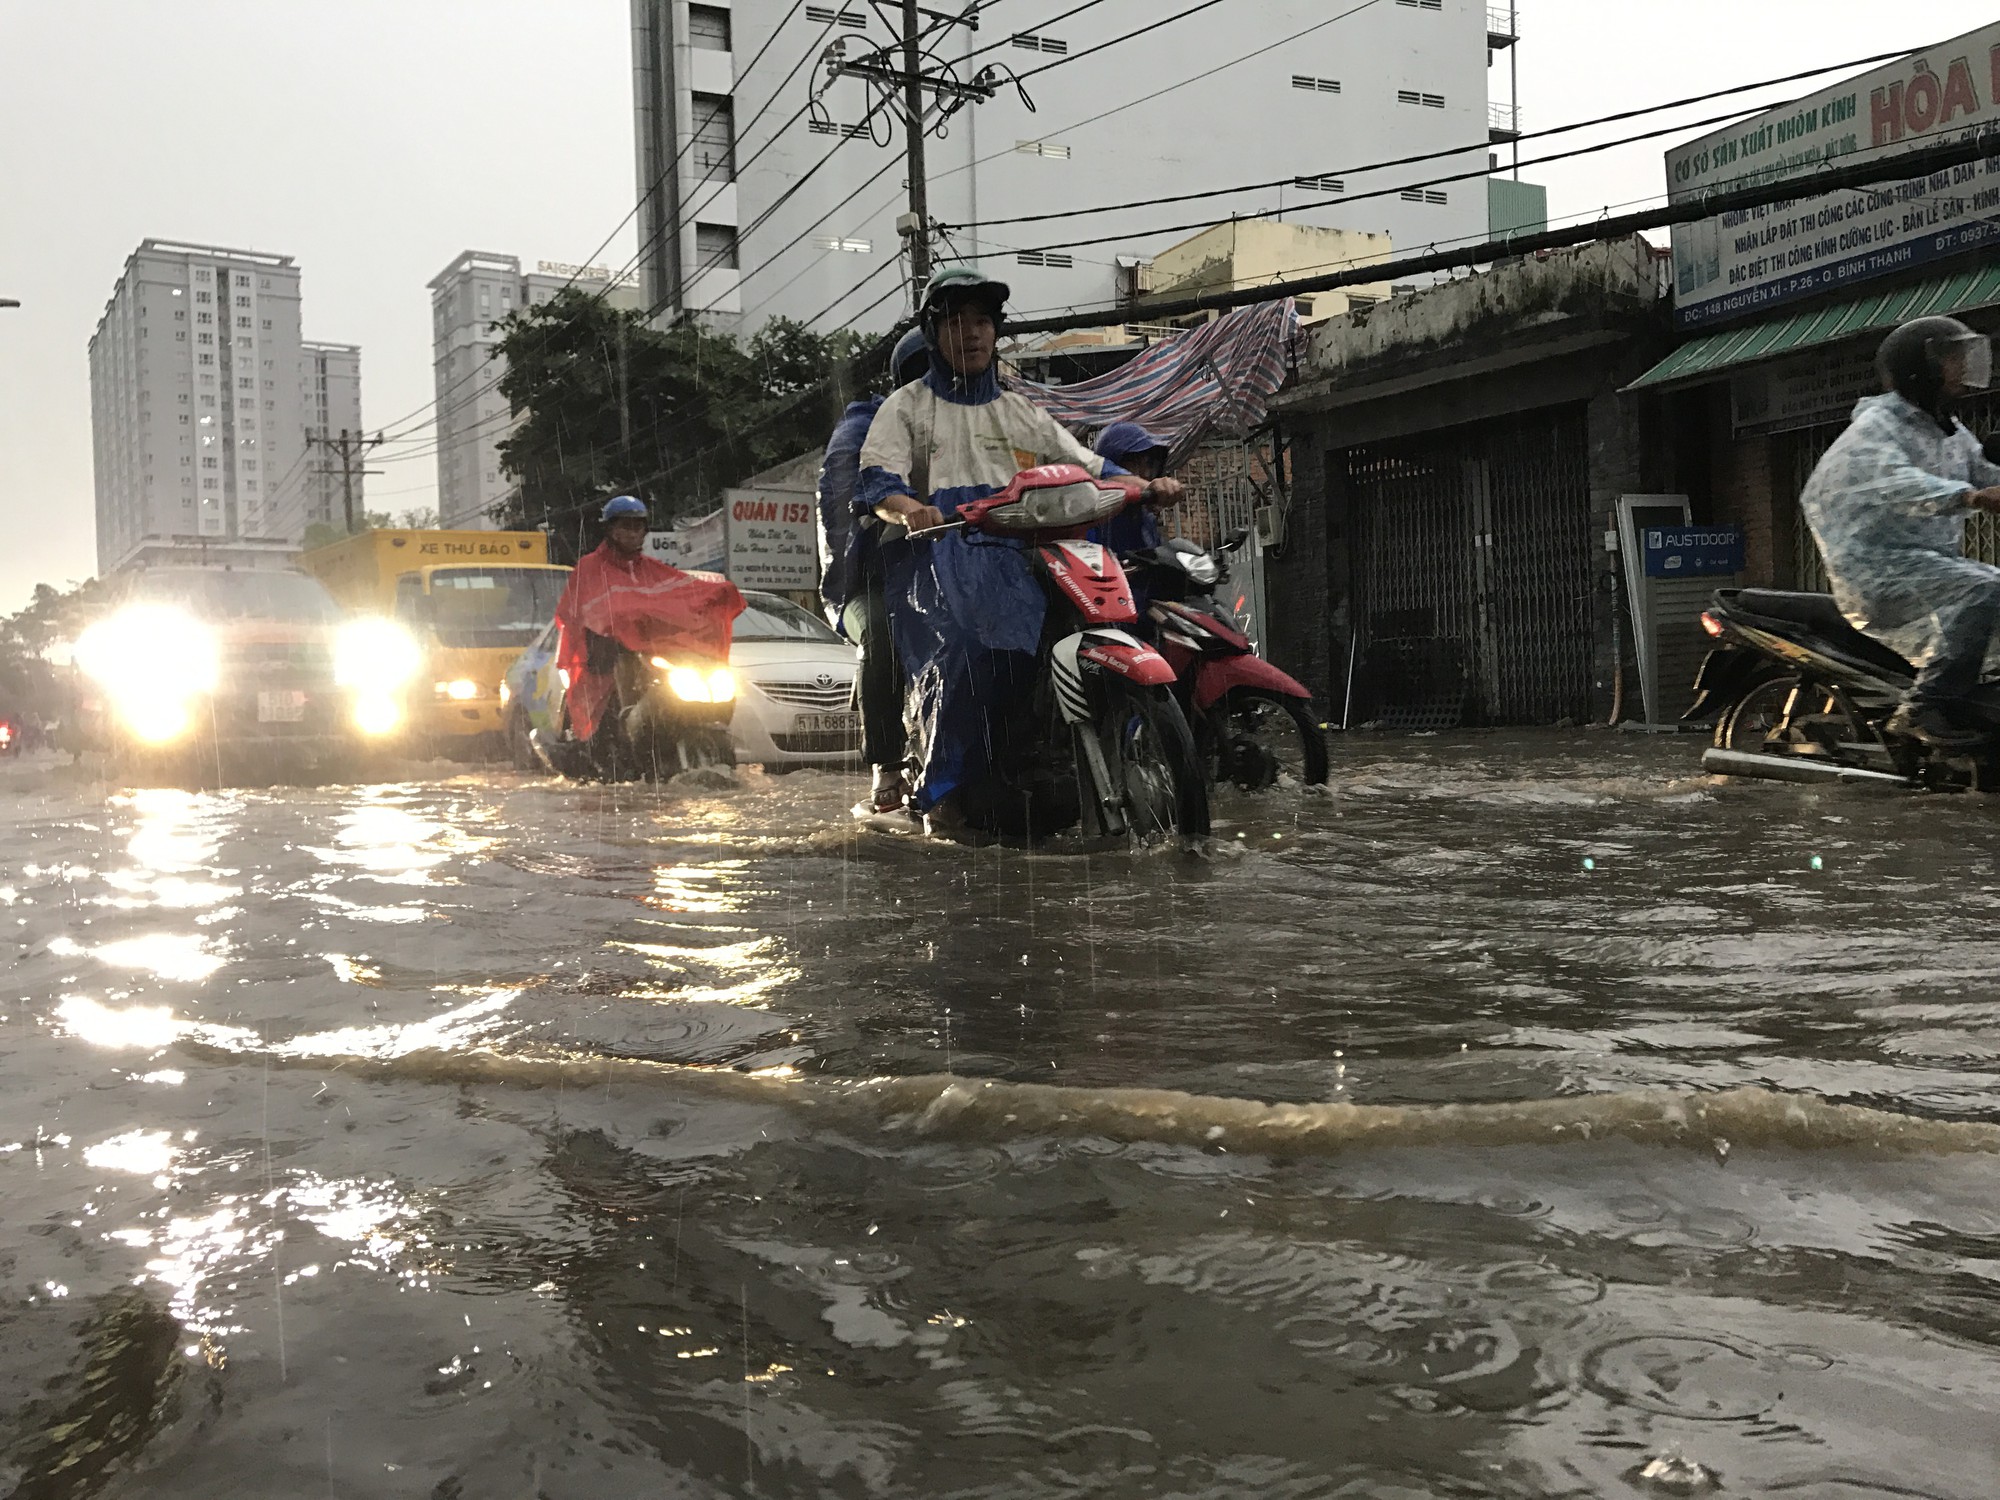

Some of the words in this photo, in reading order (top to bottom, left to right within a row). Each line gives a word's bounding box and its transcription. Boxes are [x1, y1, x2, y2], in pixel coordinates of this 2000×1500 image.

[1870, 56, 1981, 147] HÒA
[1674, 155, 1691, 183] CƠ
[1693, 145, 1709, 177] SỞ
[1713, 137, 1738, 169] SẢN
[1741, 120, 1774, 158] XUẤT
[1777, 108, 1818, 145] NHÔM
[1822, 93, 1857, 128] KÍNH
[1729, 265, 1747, 287] ĐẶC
[1749, 255, 1768, 280] BIỆT
[1771, 253, 1786, 272] THI
[1788, 244, 1813, 267] CÔNG
[1815, 236, 1838, 260] KÍNH
[1902, 205, 1924, 233] BẢN
[1973, 186, 1999, 212] KÍNH
[1735, 231, 1759, 254] NHẬN
[1779, 217, 1798, 243] ĐẶT
[1800, 213, 1816, 232] THI
[1818, 204, 1843, 228] CÔNG
[1845, 195, 1865, 220] CÁC
[1867, 189, 1894, 213] CÔNG
[1704, 302, 1721, 316] 148
[1723, 285, 1768, 311] NGUYỄN
[1790, 275, 1813, 292] P.26
[1838, 258, 1867, 279] BÌNH
[1869, 247, 1912, 269] THẠNH
[733, 497, 778, 523] QUÁN
[782, 503, 810, 524] 152
[1665, 532, 1735, 547] AUSTDOOR
[419, 543, 439, 555] XE
[444, 542, 476, 555] THƯ
[479, 541, 511, 556] BÁO
